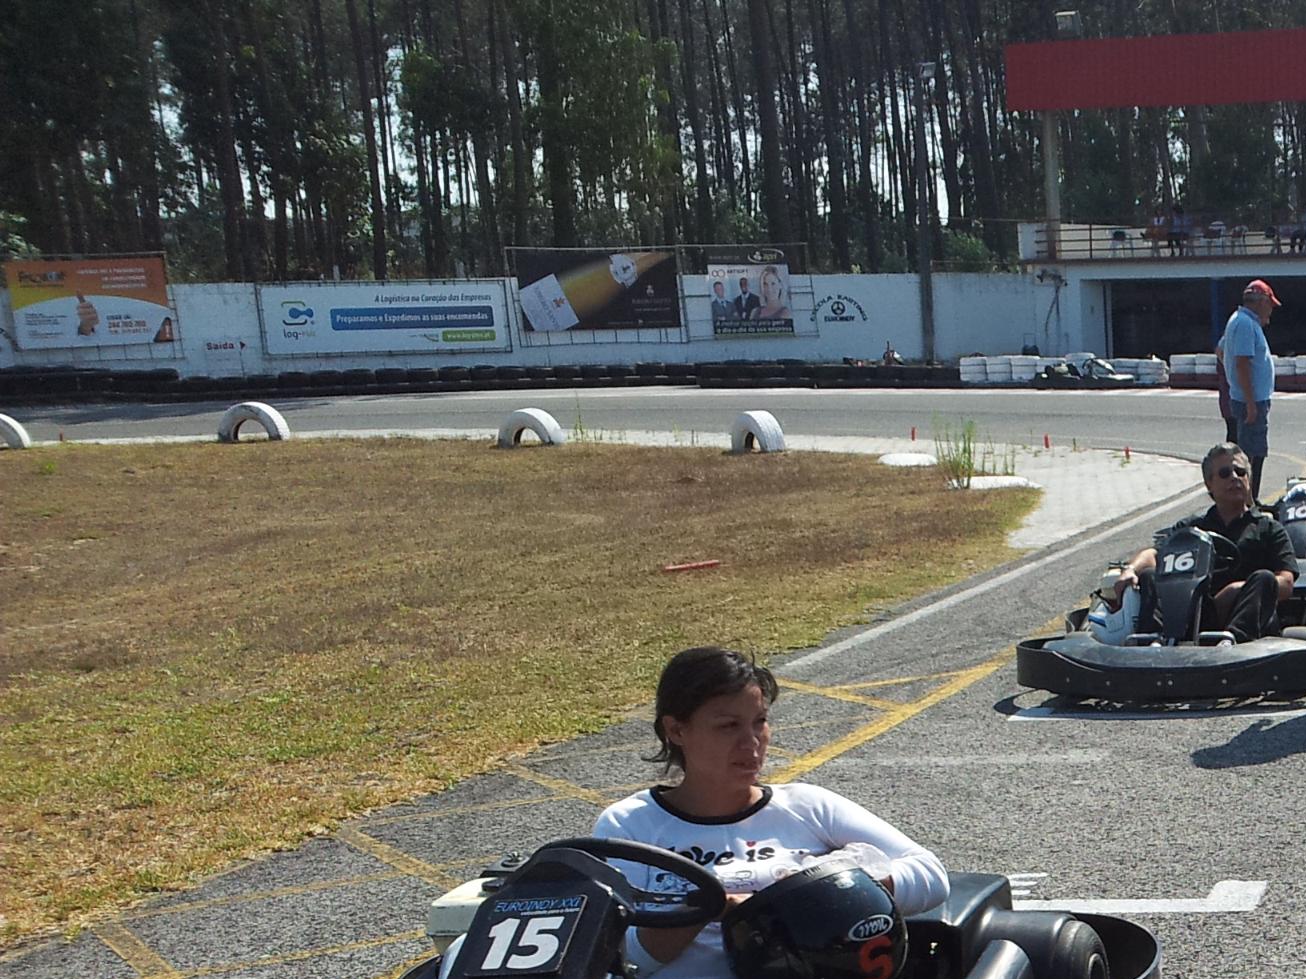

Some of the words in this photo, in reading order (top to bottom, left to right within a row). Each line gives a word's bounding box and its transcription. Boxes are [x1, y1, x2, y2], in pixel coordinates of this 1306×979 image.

[460, 293, 492, 302] Empresas
[336, 315, 378, 324] Preparamos
[384, 313, 422, 323] Expedimos
[447, 311, 489, 321] encomendas
[1163, 552, 1195, 573] 16
[666, 846, 735, 866] ove
[746, 840, 776, 863] is
[481, 916, 565, 970] 15
